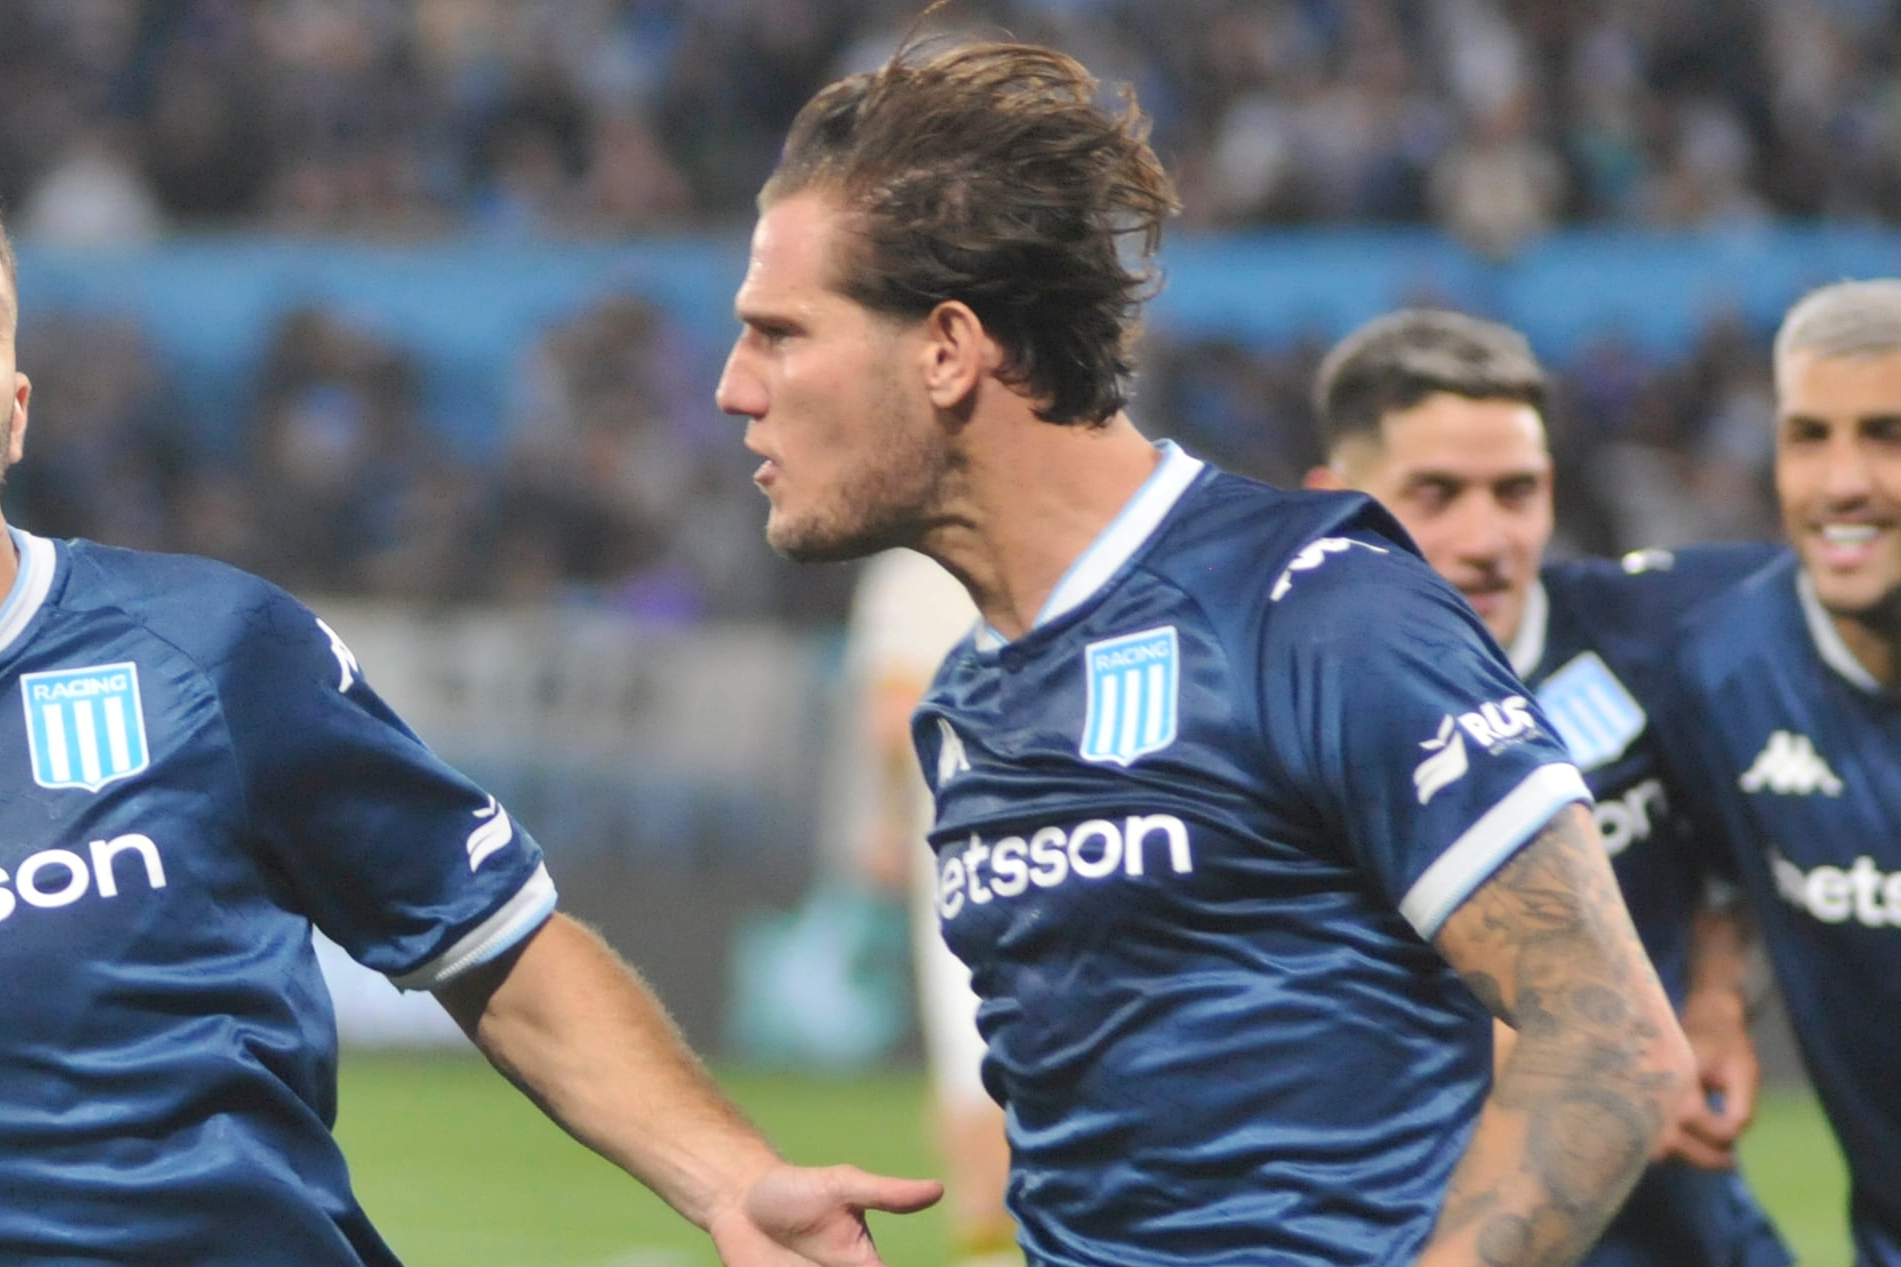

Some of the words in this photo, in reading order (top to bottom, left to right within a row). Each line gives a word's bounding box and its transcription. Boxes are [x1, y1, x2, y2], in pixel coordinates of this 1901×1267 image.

[1094, 640, 1170, 672] RACING
[32, 674, 128, 701] RACING
[939, 813, 1193, 920] etsson
